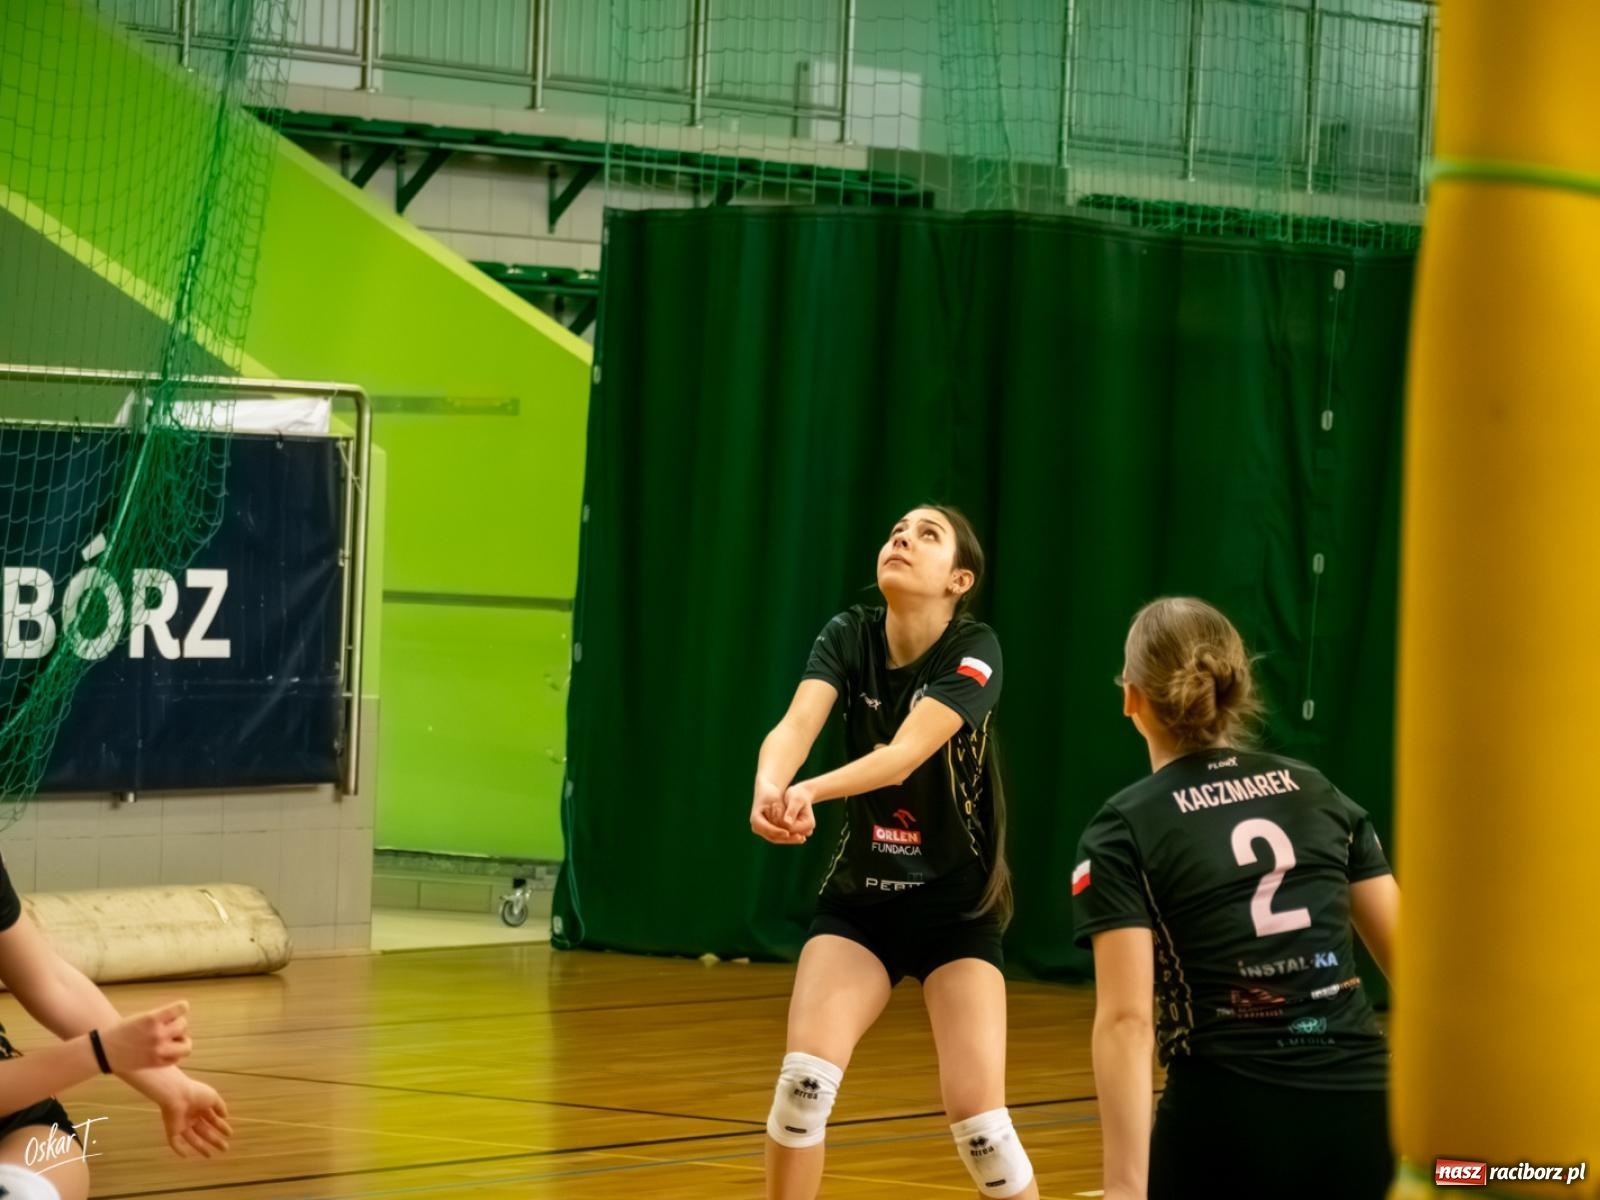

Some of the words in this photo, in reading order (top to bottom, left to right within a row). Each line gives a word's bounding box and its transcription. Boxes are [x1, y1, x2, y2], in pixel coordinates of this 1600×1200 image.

[3, 533, 231, 660] BÓRZ
[1173, 769, 1300, 813] KACZMAREK
[872, 842, 922, 856] FUNDACJA
[876, 829, 918, 842] ORLEN
[1231, 817, 1312, 937] 2
